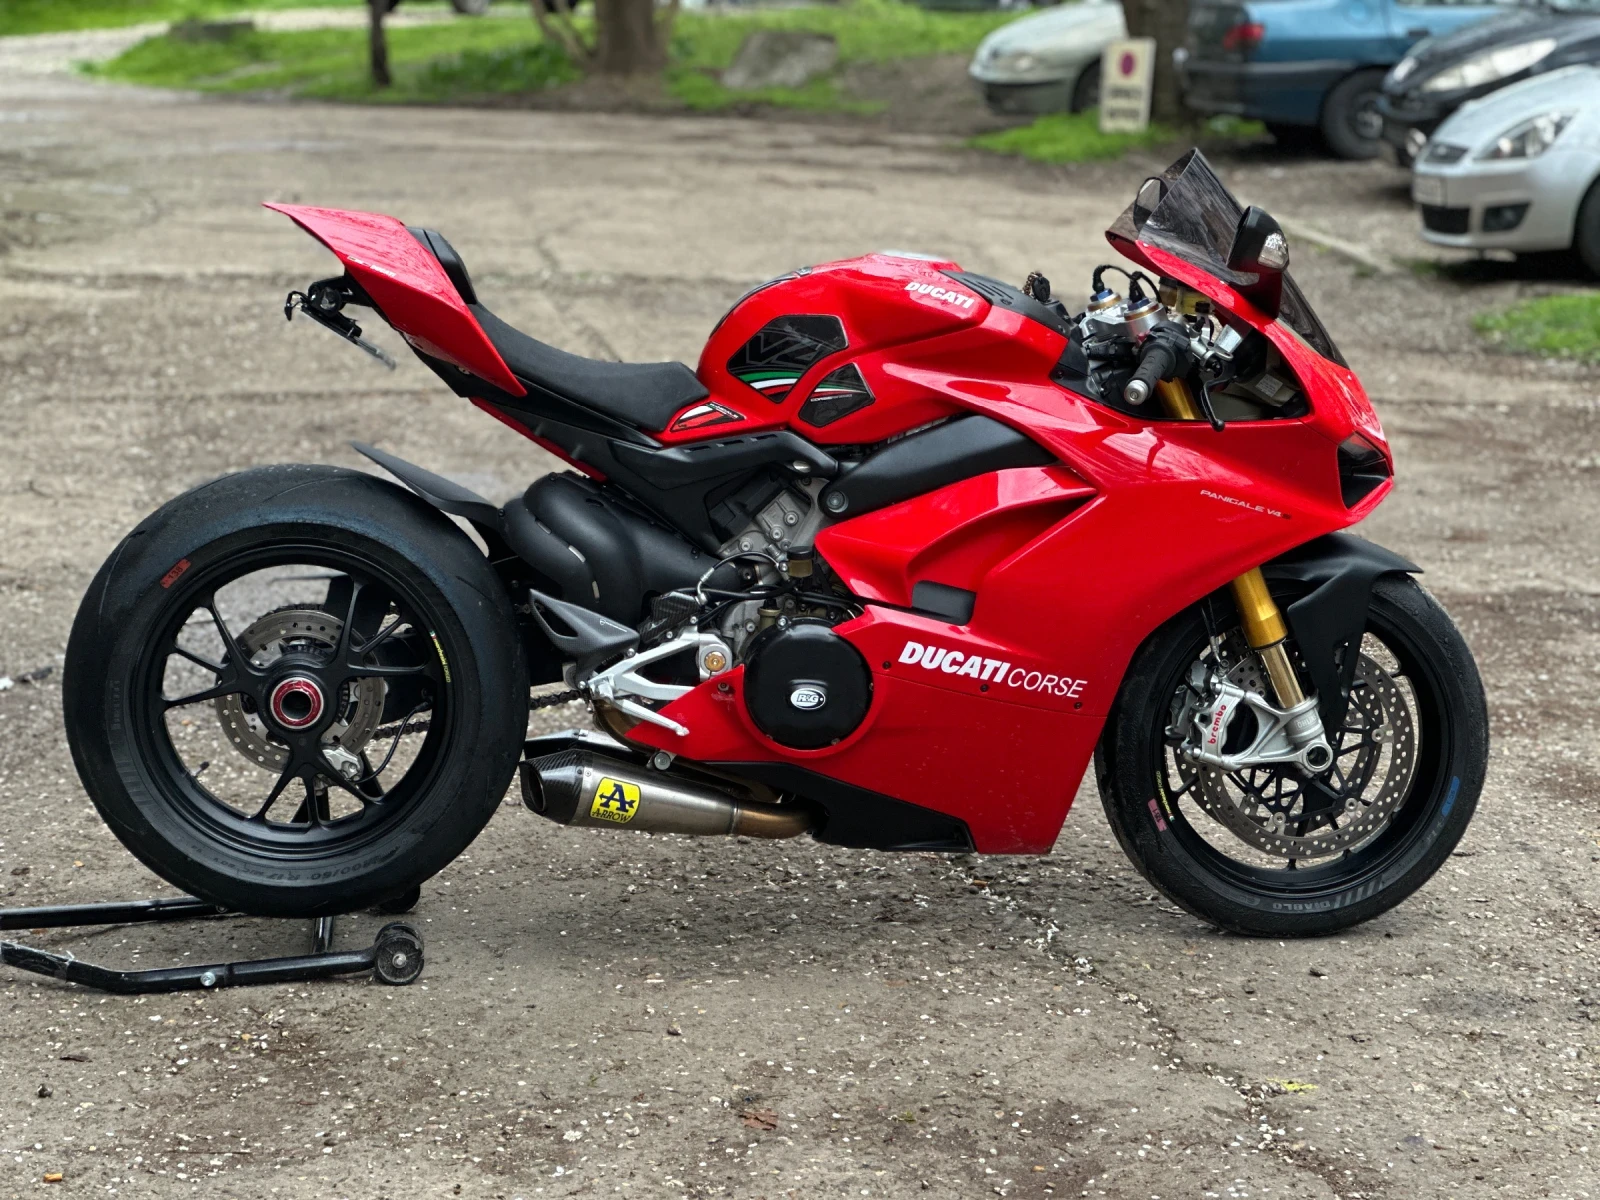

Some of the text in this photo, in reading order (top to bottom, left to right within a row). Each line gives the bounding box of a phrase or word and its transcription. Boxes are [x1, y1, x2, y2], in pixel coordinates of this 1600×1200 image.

[904, 282, 974, 308] DUCATI
[1200, 490, 1264, 512] PANIGALE
[898, 641, 1087, 698] DUCATI CORSE
[1207, 705, 1227, 744] brembo
[592, 808, 631, 822] ARROW
[1272, 900, 1330, 910] DIABLO
